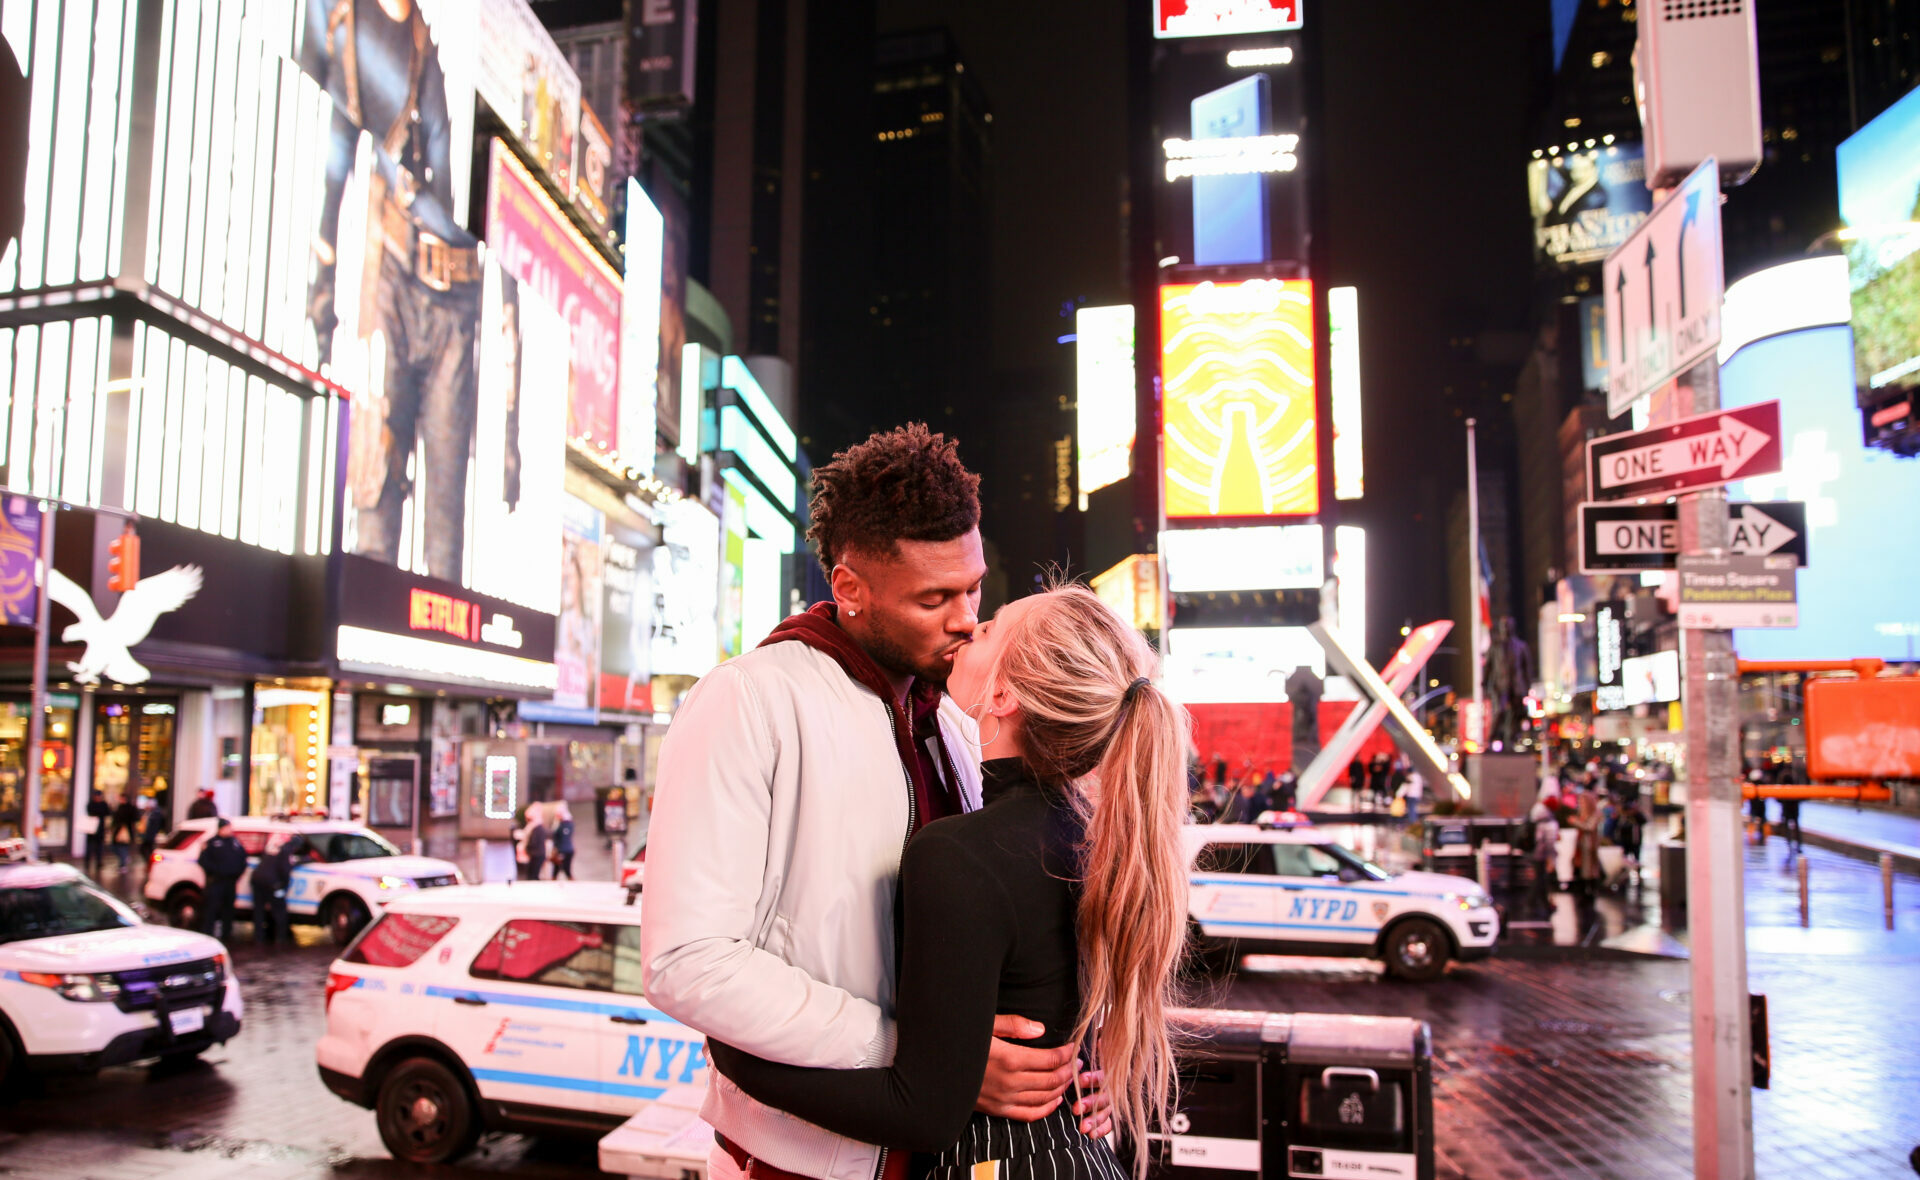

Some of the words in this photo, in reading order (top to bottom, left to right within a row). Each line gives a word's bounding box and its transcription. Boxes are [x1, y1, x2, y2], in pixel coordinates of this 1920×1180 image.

[1613, 448, 1663, 481] ONE
[1689, 430, 1747, 466] WAY
[1614, 524, 1677, 549] ONE
[1731, 523, 1771, 548] AY
[1683, 572, 1724, 587] Times
[1726, 571, 1778, 589] Square
[1682, 587, 1754, 601] Pedestrian
[1756, 588, 1792, 600] Plaza
[410, 588, 471, 640] NETFLIX
[1288, 896, 1358, 922] NYPD
[617, 1034, 707, 1085] NYP
